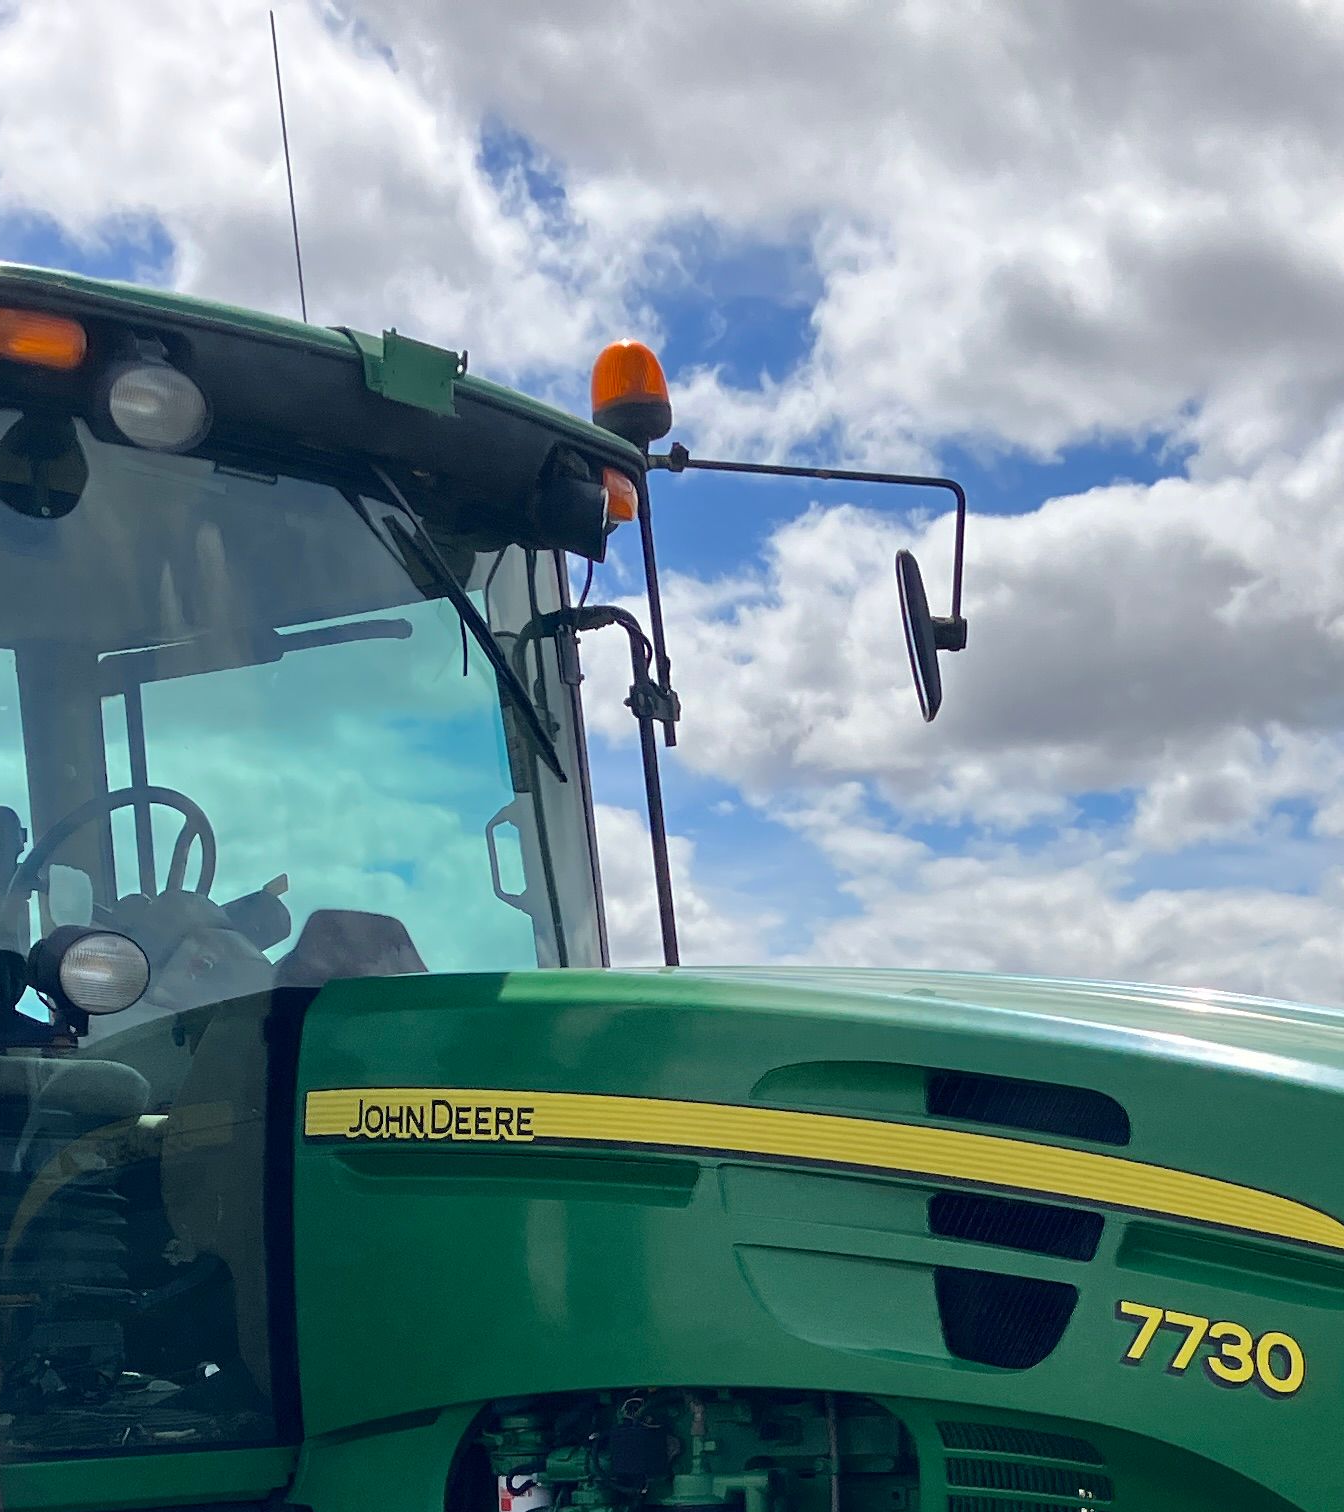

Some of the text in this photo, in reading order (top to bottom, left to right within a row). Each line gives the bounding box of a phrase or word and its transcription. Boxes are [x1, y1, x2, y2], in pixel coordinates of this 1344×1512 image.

[349, 1099, 534, 1136] JOHN DEERE
[1118, 1300, 1306, 1395] 7730
